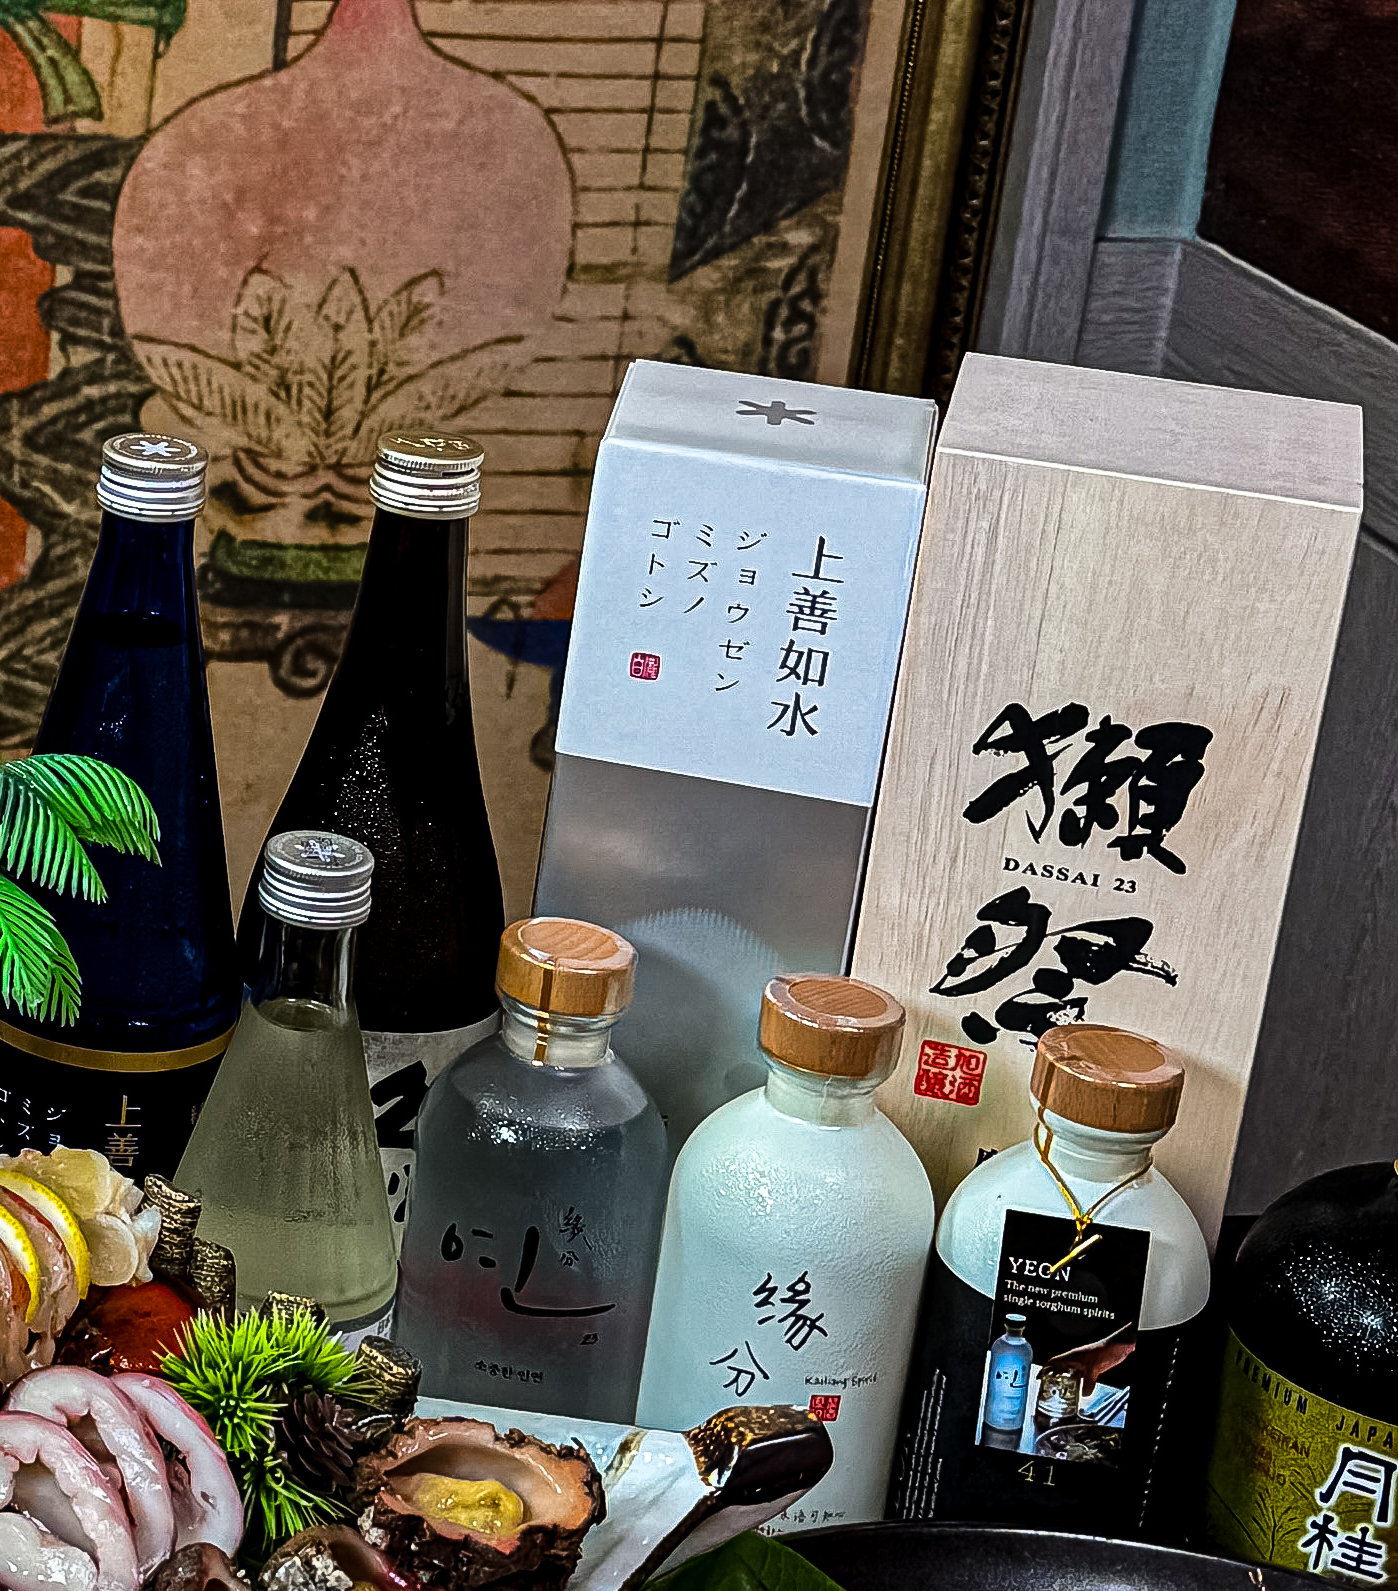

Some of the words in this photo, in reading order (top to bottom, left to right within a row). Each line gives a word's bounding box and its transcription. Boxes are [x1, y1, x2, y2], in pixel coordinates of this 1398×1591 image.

[639, 519, 681, 608] ゴトシ
[683, 523, 718, 614] ミズノ
[715, 530, 768, 692] ジョウゼン
[766, 535, 845, 737] 上善如水
[1003, 857, 1100, 888] DASSAI
[1112, 876, 1138, 895] 23
[103, 1093, 143, 1167] 上善
[1005, 1279, 1025, 1290] The
[1027, 1284, 1050, 1295] new
[1050, 1289, 1099, 1304] premium
[1008, 1256, 1072, 1282] YEON
[1003, 1293, 1034, 1307] single
[1035, 1300, 1081, 1312] sorghum
[1082, 1307, 1116, 1320] spirits
[1235, 1348, 1309, 1416] PREMIUM
[1017, 1460, 1056, 1486] 41
[1301, 1446, 1398, 1580] 月桂
